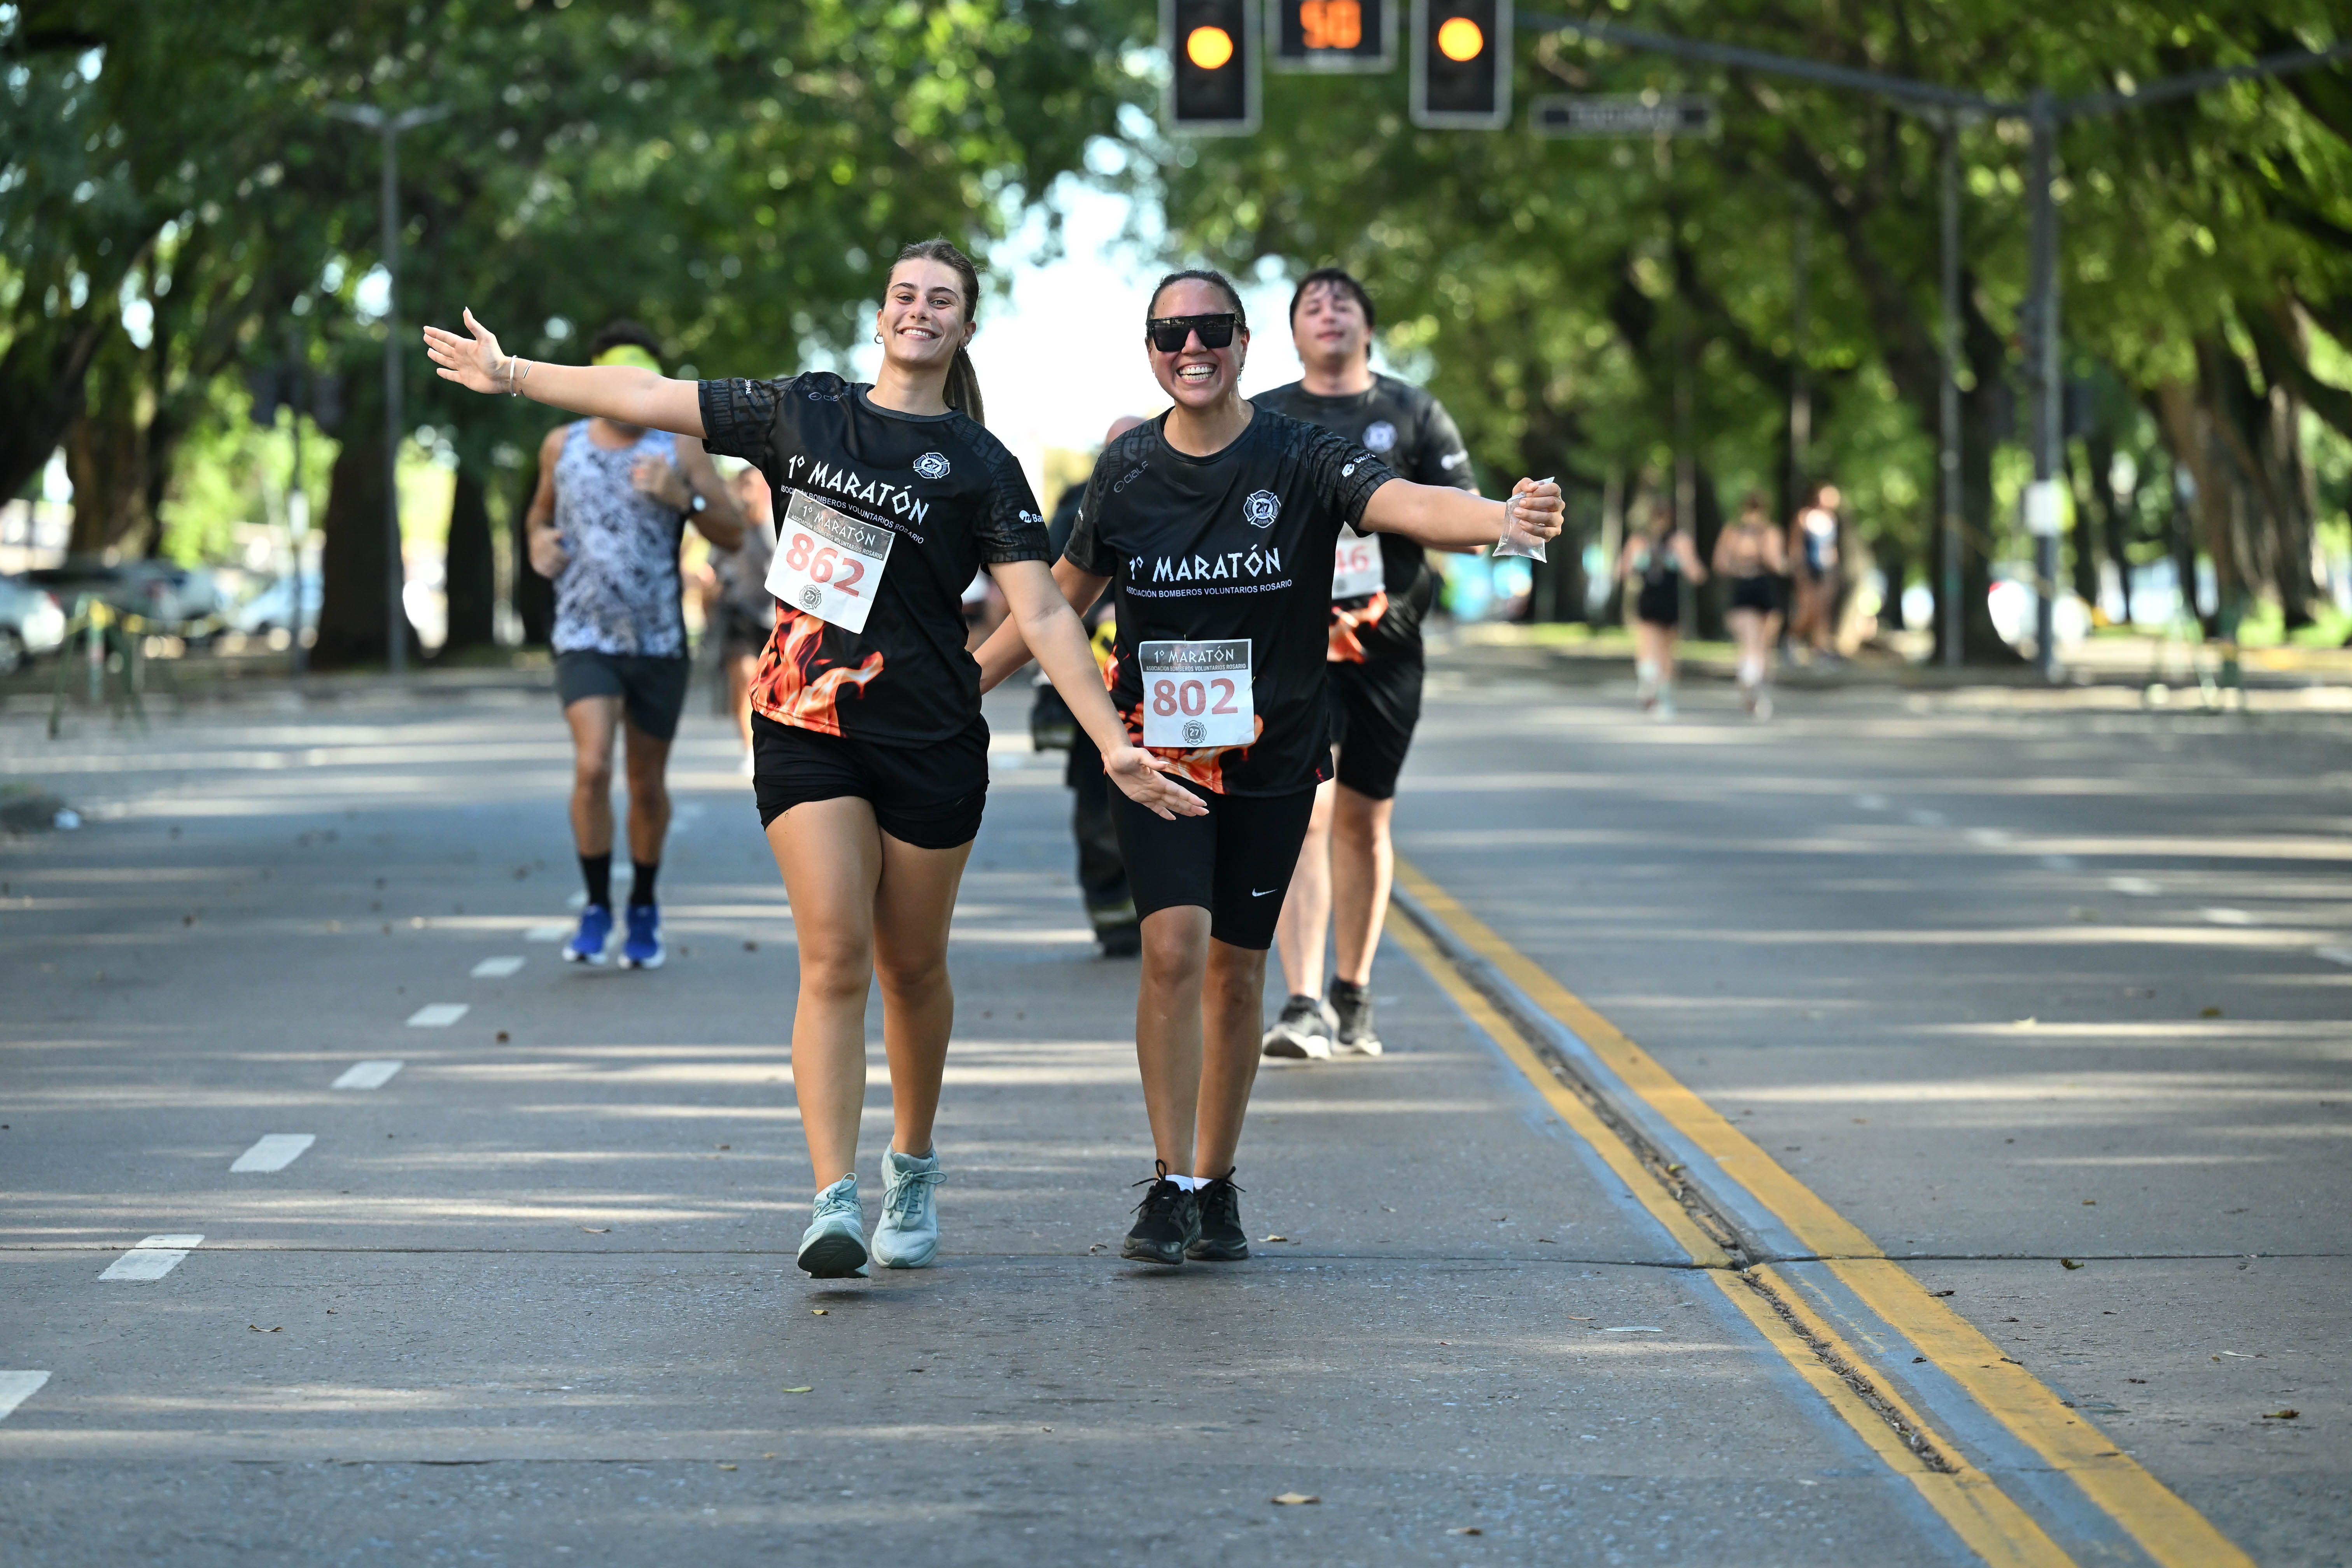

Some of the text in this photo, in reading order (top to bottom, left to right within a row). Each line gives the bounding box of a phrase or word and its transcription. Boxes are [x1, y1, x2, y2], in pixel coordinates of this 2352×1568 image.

[924, 459, 940, 470] 27
[807, 460, 929, 525] MARATÓN
[1256, 502, 1270, 514] 27
[791, 514, 882, 559] ASOCIACIÓN BOMBEROS VOLUNTARIOS ROSARIO
[809, 493, 846, 508] BOMBEROS
[849, 504, 894, 528] VOLUNTARIOS
[895, 523, 924, 544] ROSARIO
[814, 511, 876, 547] MARATÓN
[786, 533, 864, 597] 862
[1152, 544, 1281, 582] MARATÓN
[805, 591, 815, 601] 27
[1126, 579, 1292, 598] ASOCIACIÓN BOMBEROS VOLUNTARIOS ROSARIO
[1169, 646, 1234, 663] MARATÓN
[1153, 678, 1238, 716] 802
[1190, 728, 1199, 737] 27
